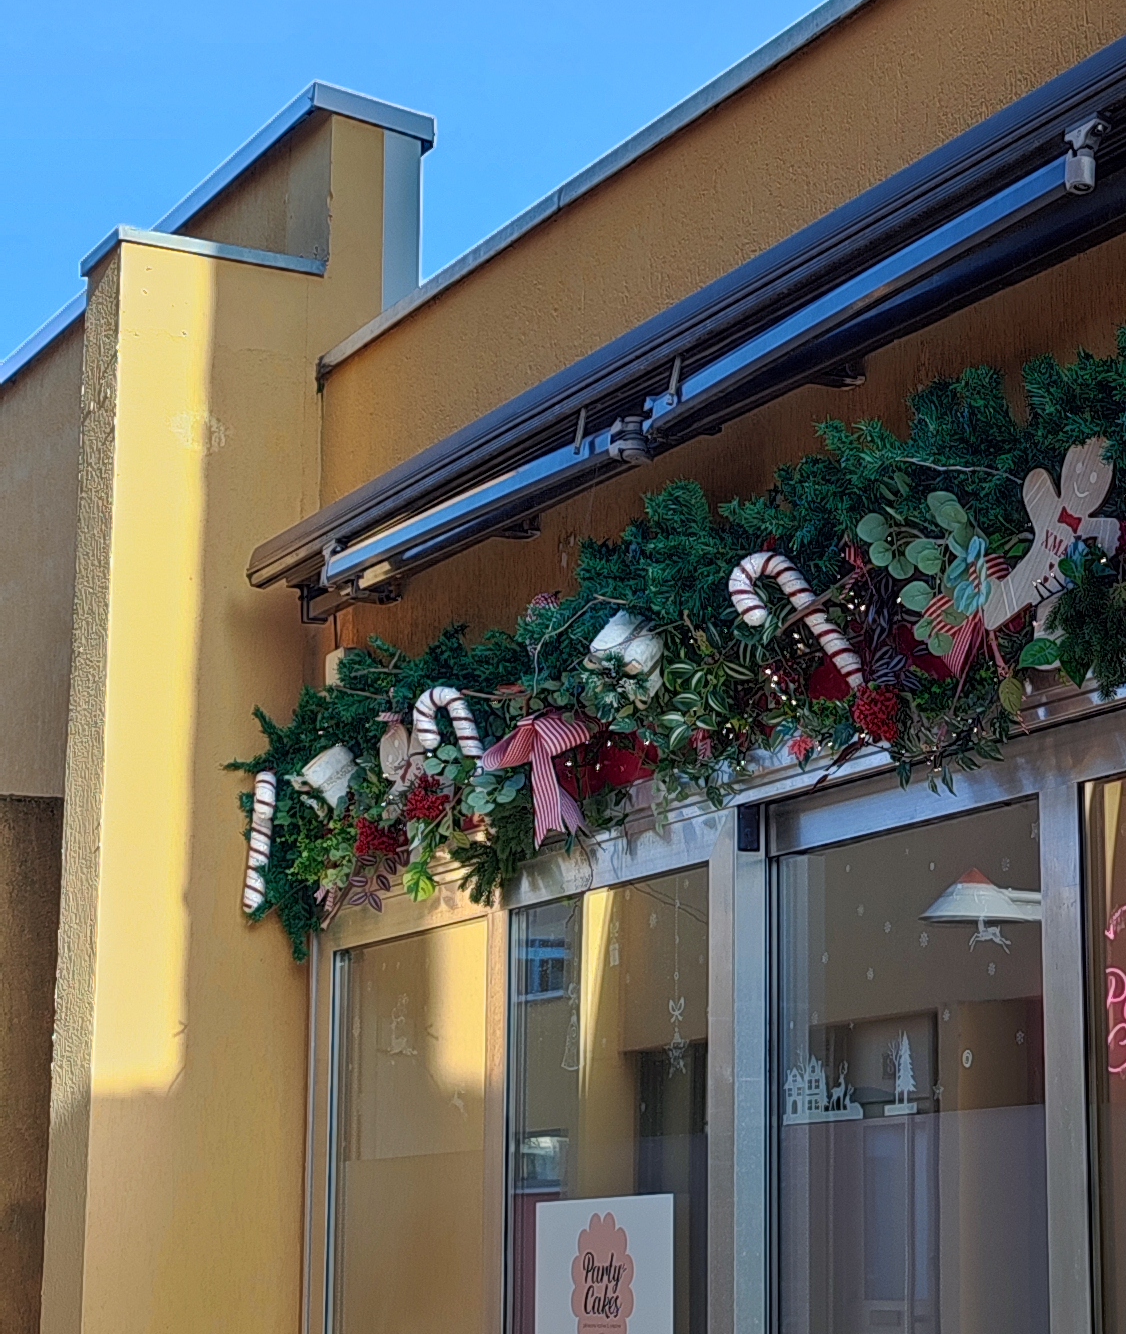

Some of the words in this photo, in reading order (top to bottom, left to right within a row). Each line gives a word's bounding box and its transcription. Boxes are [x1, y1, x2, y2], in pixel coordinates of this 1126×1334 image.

[1041, 528, 1069, 558] XMA
[583, 1251, 621, 1294] Party
[583, 1284, 622, 1319] Cakes
